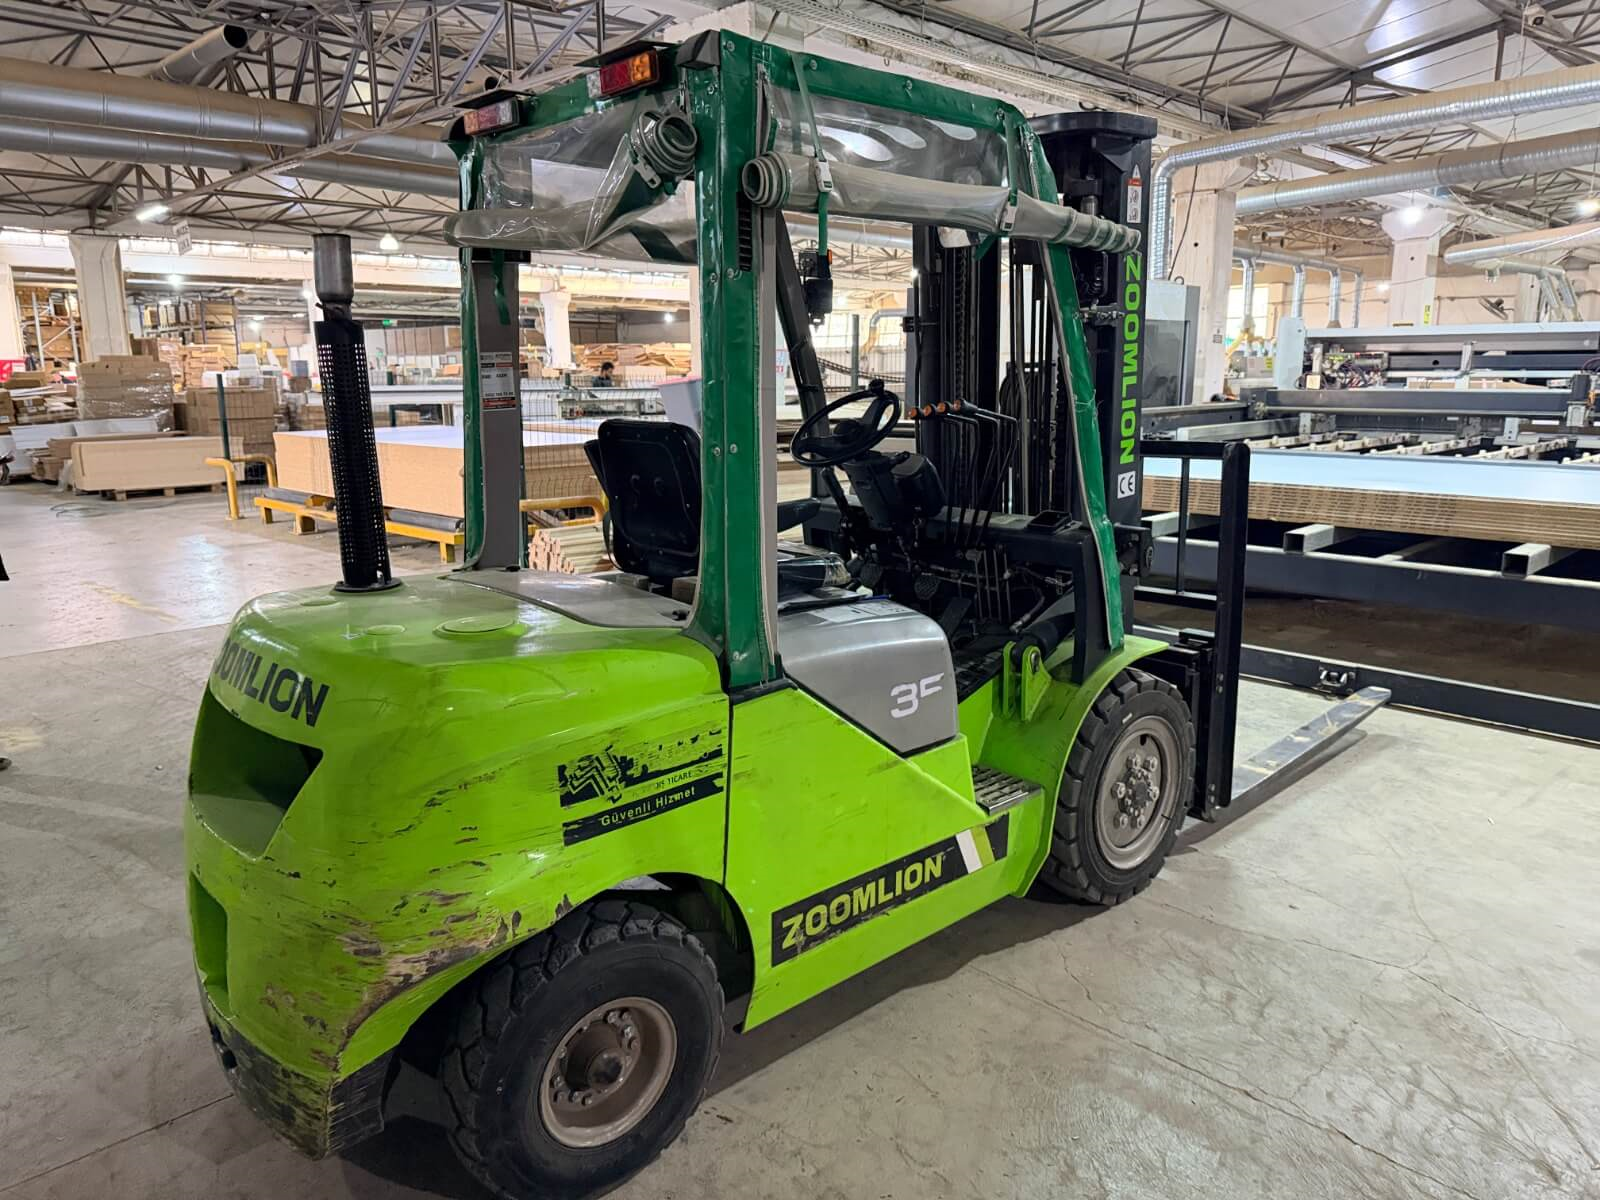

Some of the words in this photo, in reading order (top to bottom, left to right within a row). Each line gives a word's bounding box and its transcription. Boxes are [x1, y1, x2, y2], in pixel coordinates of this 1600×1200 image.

[1119, 255, 1142, 464] ZOOMLION
[601, 802, 651, 826] Güvenli
[782, 853, 944, 949] ZOOMLION
